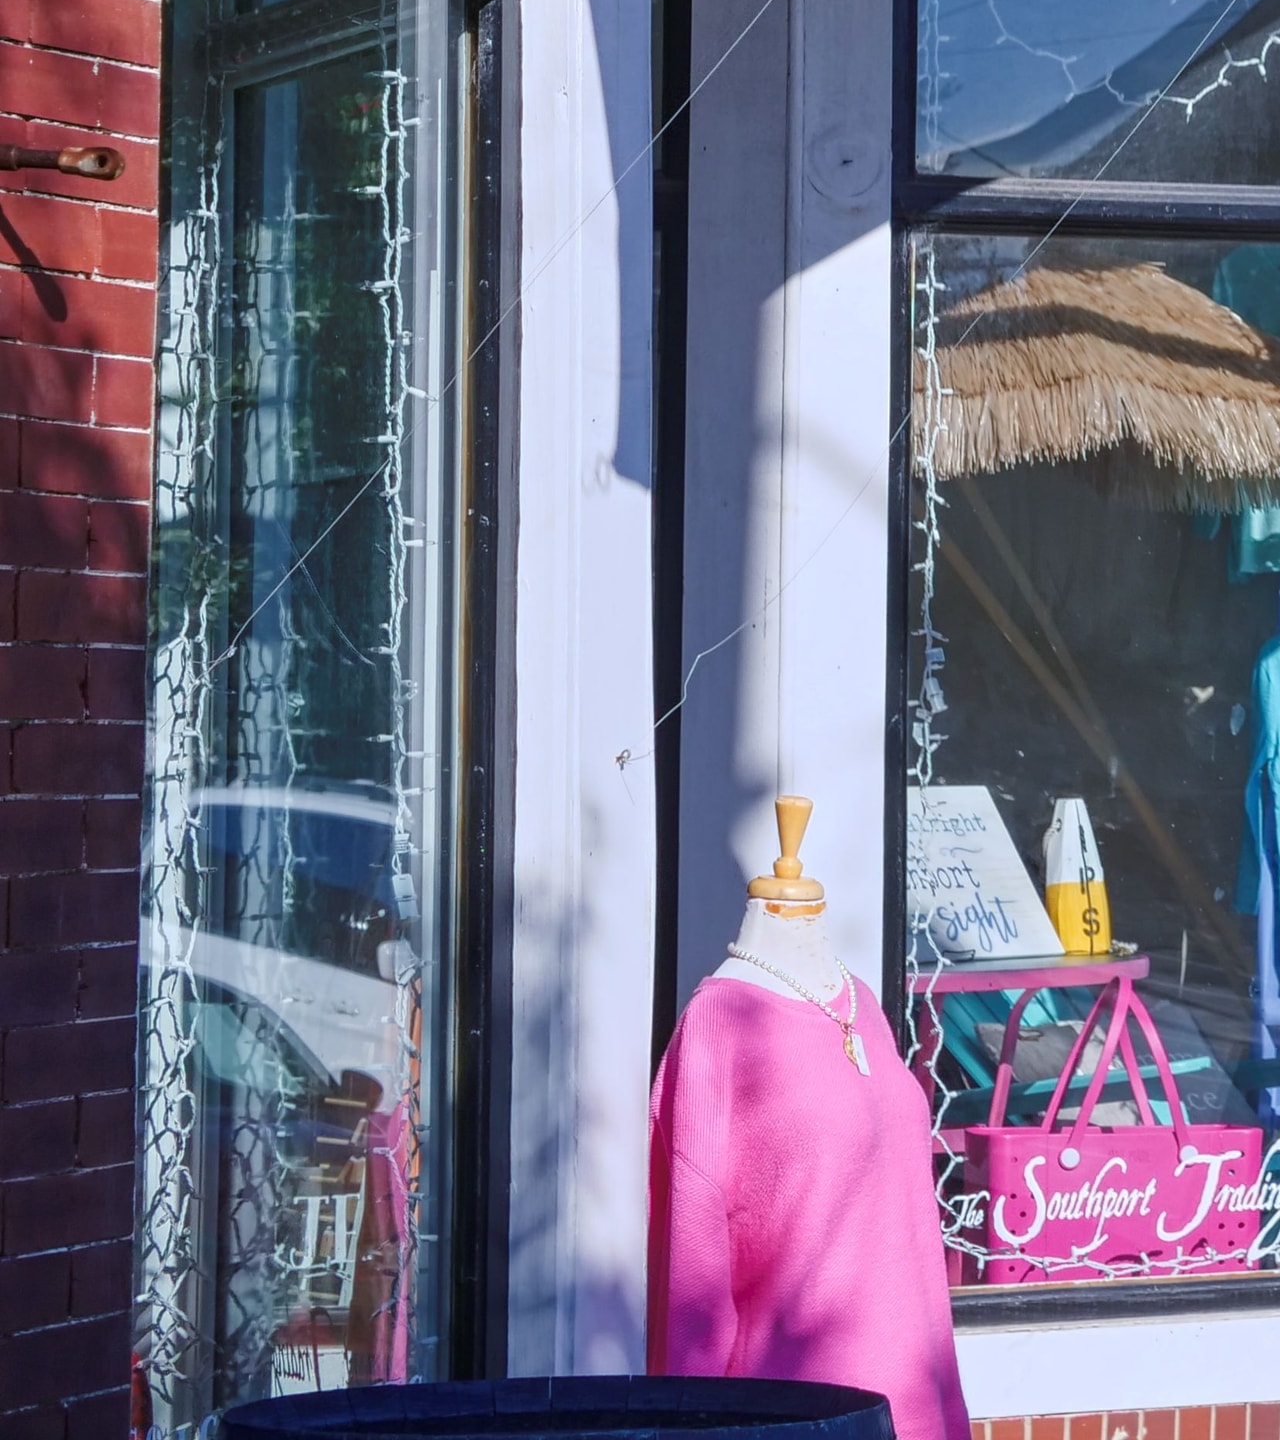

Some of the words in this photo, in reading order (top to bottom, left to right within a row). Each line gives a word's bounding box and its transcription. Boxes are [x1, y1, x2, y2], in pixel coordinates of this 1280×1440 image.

[936, 891, 1019, 952] sight
[941, 1190, 990, 1234] The
[993, 1155, 1156, 1258] Southport
